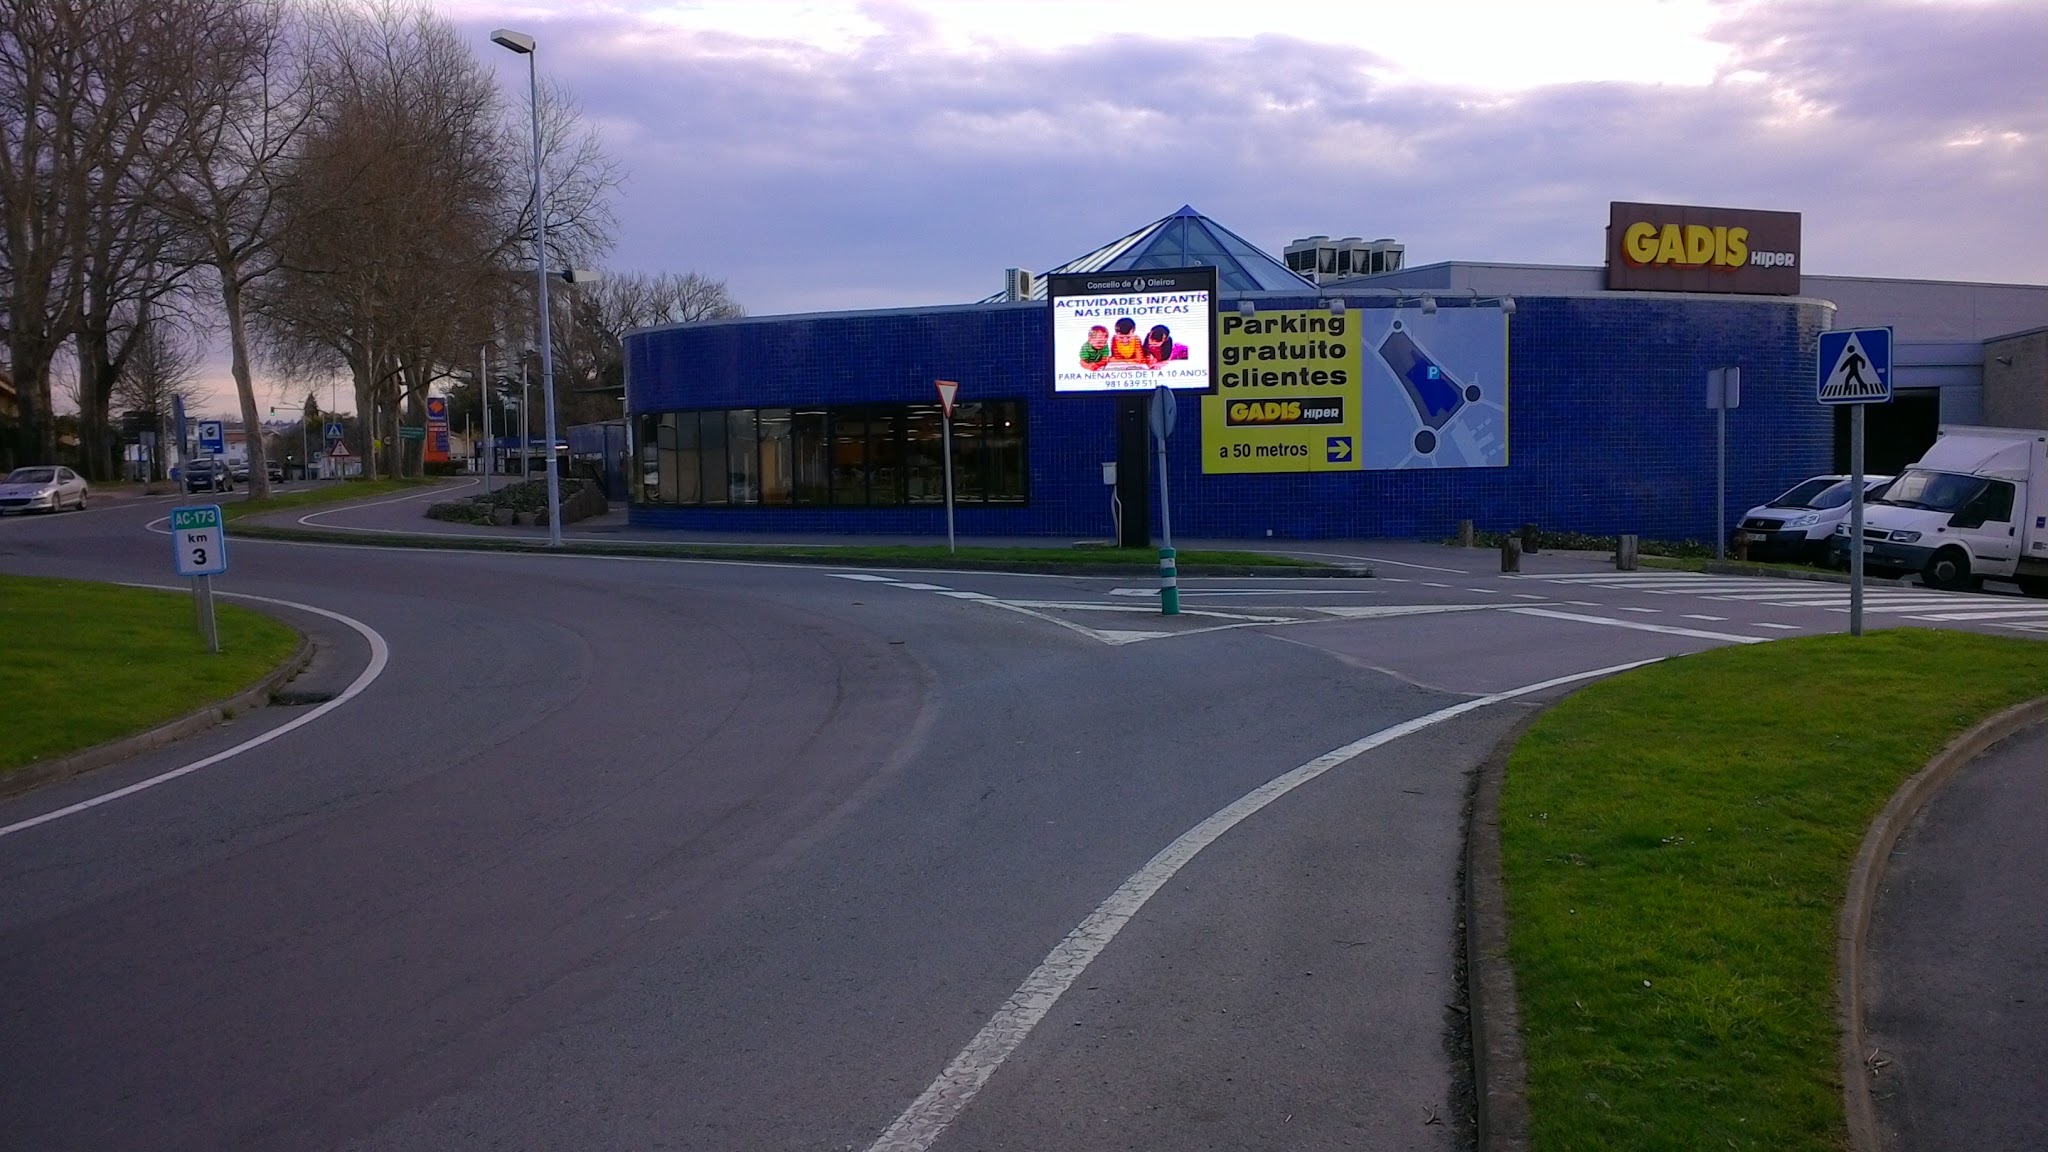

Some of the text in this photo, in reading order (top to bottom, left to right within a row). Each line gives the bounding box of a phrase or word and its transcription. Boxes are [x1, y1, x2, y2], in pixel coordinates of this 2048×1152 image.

[1625, 221, 1749, 269] GADIS
[1087, 278, 1175, 290] Concello de Oleiros
[1056, 292, 1208, 308] ACTIVIDADES INFANTÍS
[1074, 305, 1189, 318] NAS BIBLIOTECAS
[1223, 313, 1345, 336] Parking
[1222, 340, 1347, 365] gratuito
[1058, 372, 1082, 381] PARA
[1084, 371, 1133, 380] NENAS/OS
[1135, 370, 1147, 379] DE
[1157, 370, 1164, 378] A
[1167, 369, 1177, 378] 10
[1180, 368, 1208, 378] ANOS
[1221, 367, 1348, 388] clientes
[1429, 367, 1438, 378] P
[1105, 380, 1121, 388] 981
[1123, 379, 1140, 387] 639
[1229, 401, 1302, 424] GADIS
[1219, 441, 1308, 458] a 50 metros
[176, 510, 215, 525] AC-173
[188, 534, 207, 543] km
[192, 548, 207, 565] 3
